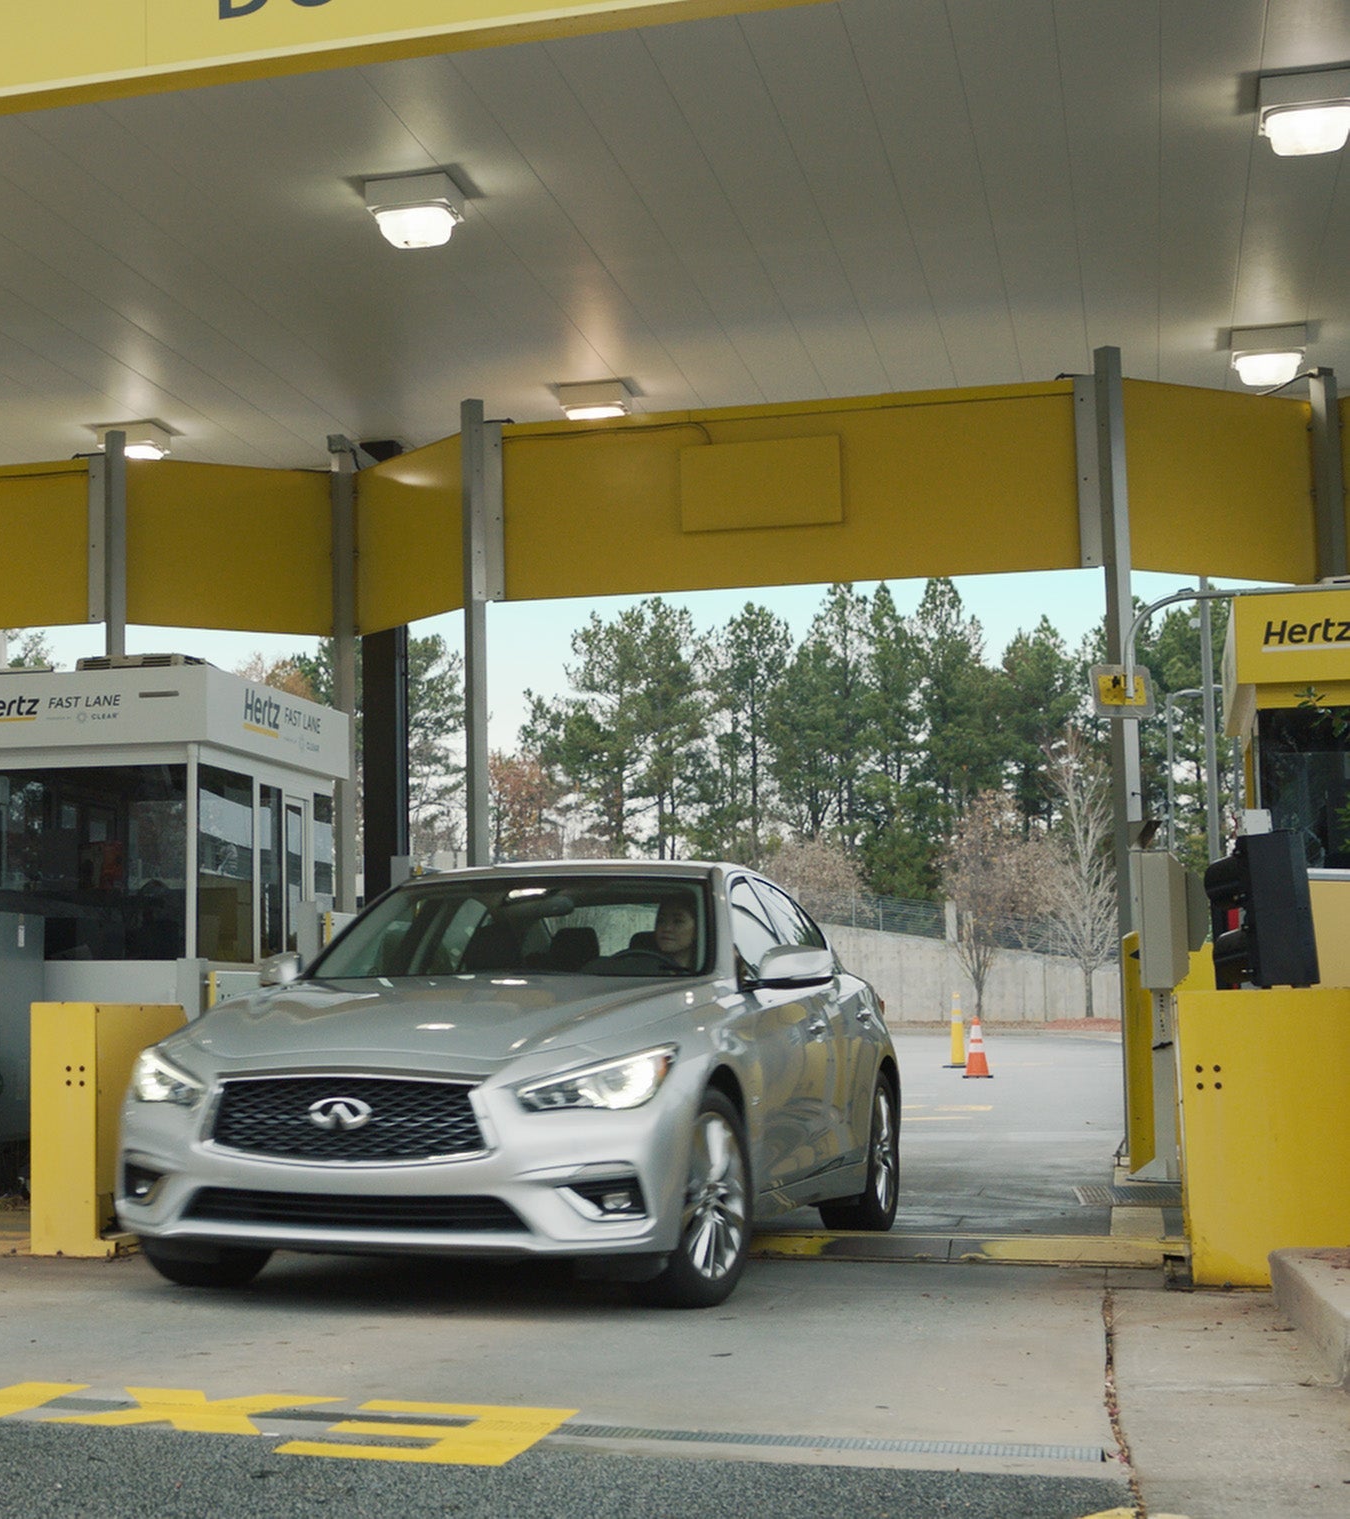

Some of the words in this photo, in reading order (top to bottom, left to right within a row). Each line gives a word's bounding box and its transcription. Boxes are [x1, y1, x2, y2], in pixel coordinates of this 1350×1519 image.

[1263, 618, 1350, 645] Hertz
[48, 696, 81, 709] FAST
[85, 694, 121, 708] LANE
[244, 688, 281, 730] Hertz
[284, 707, 302, 728] FAST
[91, 712, 118, 720] CLEAR
